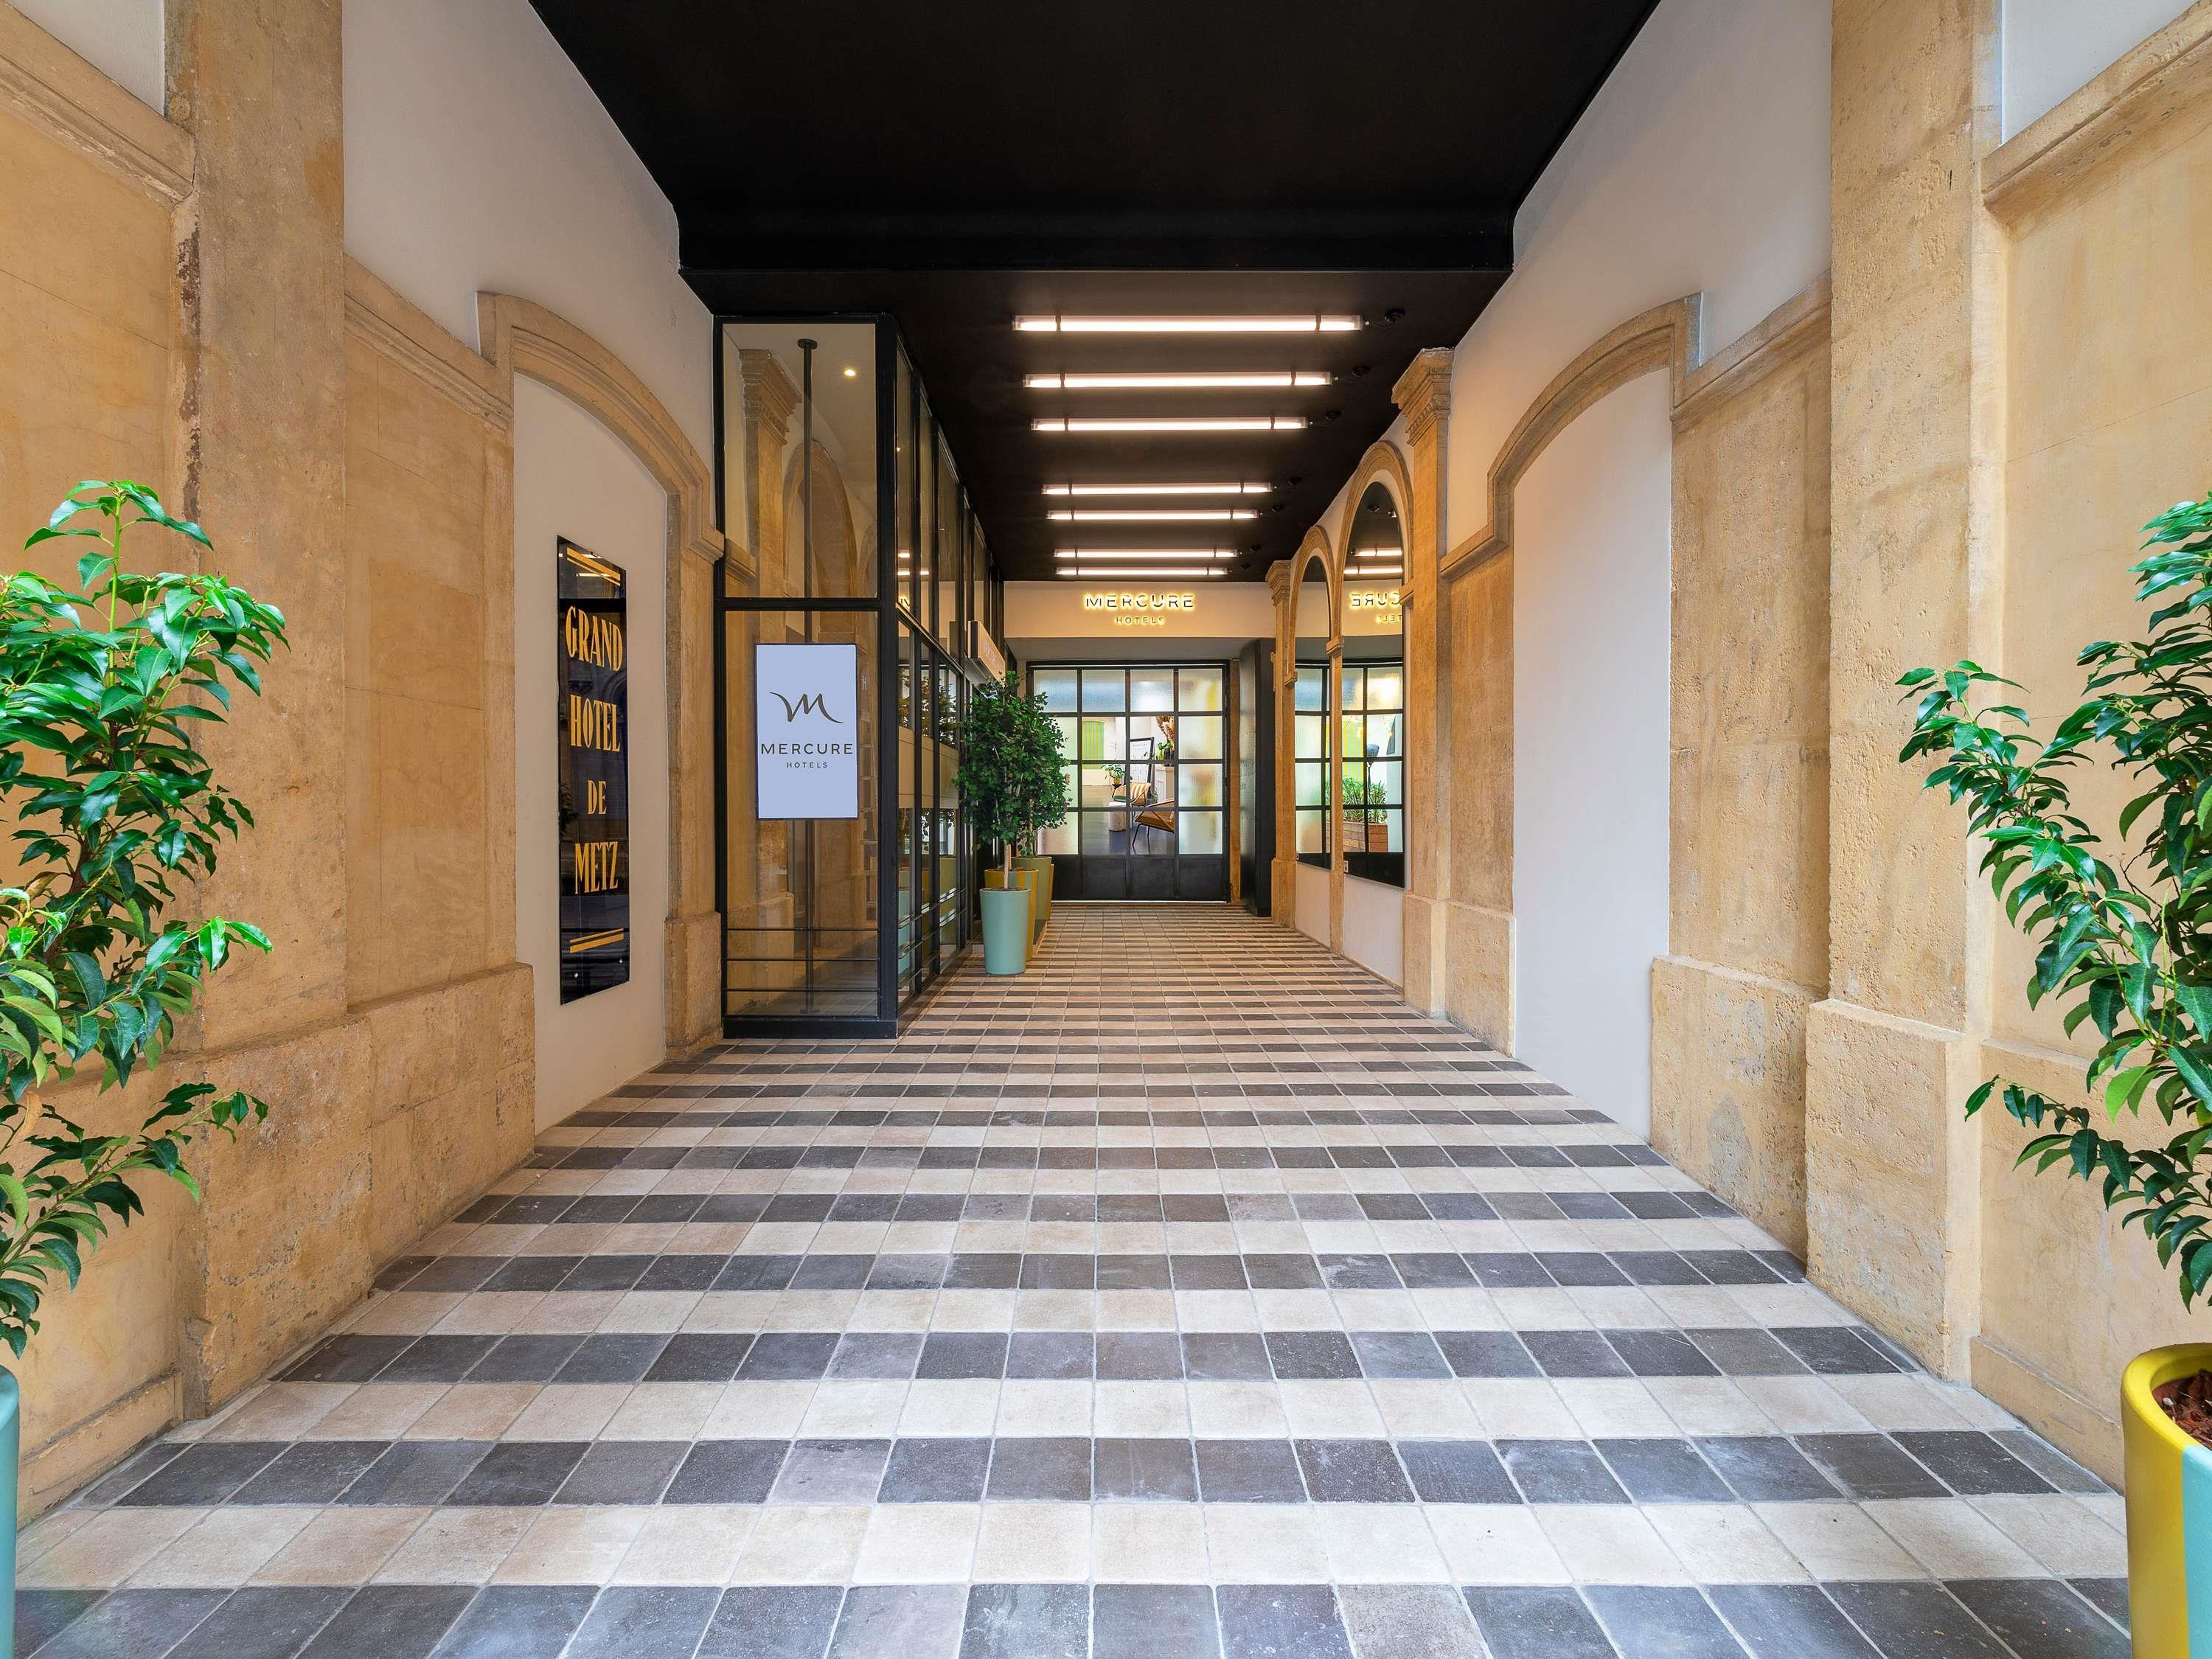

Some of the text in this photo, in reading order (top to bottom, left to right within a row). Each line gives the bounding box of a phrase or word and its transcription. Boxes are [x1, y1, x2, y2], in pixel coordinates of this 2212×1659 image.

[1085, 594, 1194, 608] MERCURE
[566, 605, 623, 672] GRAND
[1116, 616, 1164, 625] HOTELS
[570, 694, 621, 752] HOTEL
[761, 743, 853, 755] MERCURE
[587, 778, 607, 815] DE
[574, 841, 619, 894] METZ
